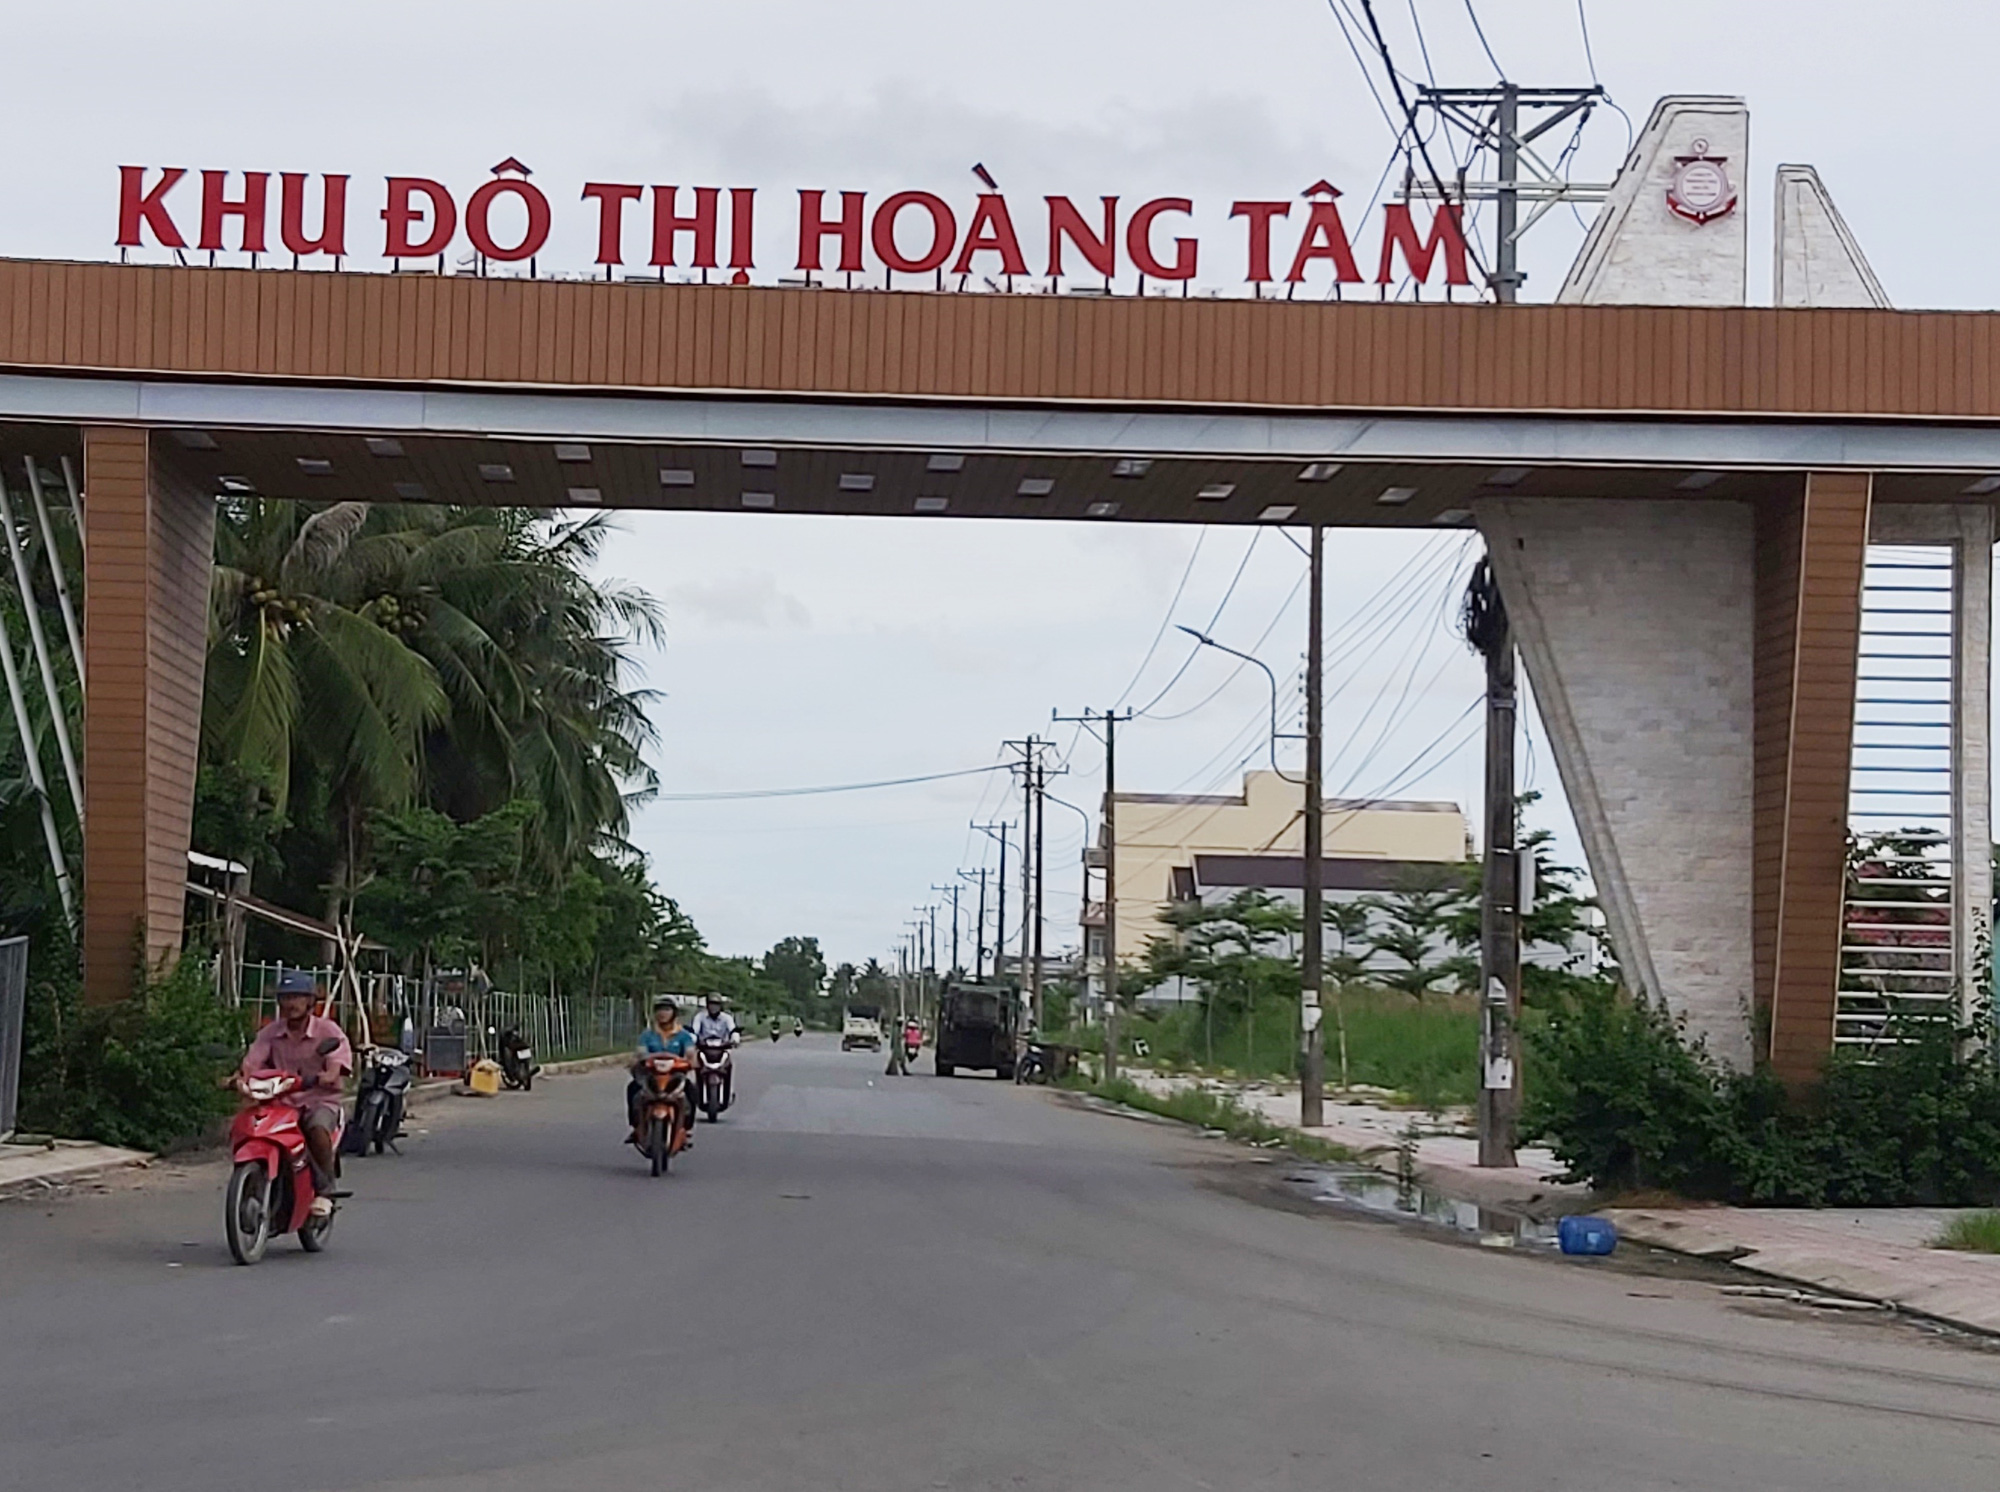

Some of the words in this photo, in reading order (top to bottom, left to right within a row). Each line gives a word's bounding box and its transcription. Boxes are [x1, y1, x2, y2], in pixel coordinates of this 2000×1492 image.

[116, 165, 350, 256] KHU
[380, 157, 552, 262] ĐÔ
[581, 182, 756, 285] THỊ
[796, 163, 1199, 280] HOÀNG
[1229, 179, 1471, 286] TÂM
